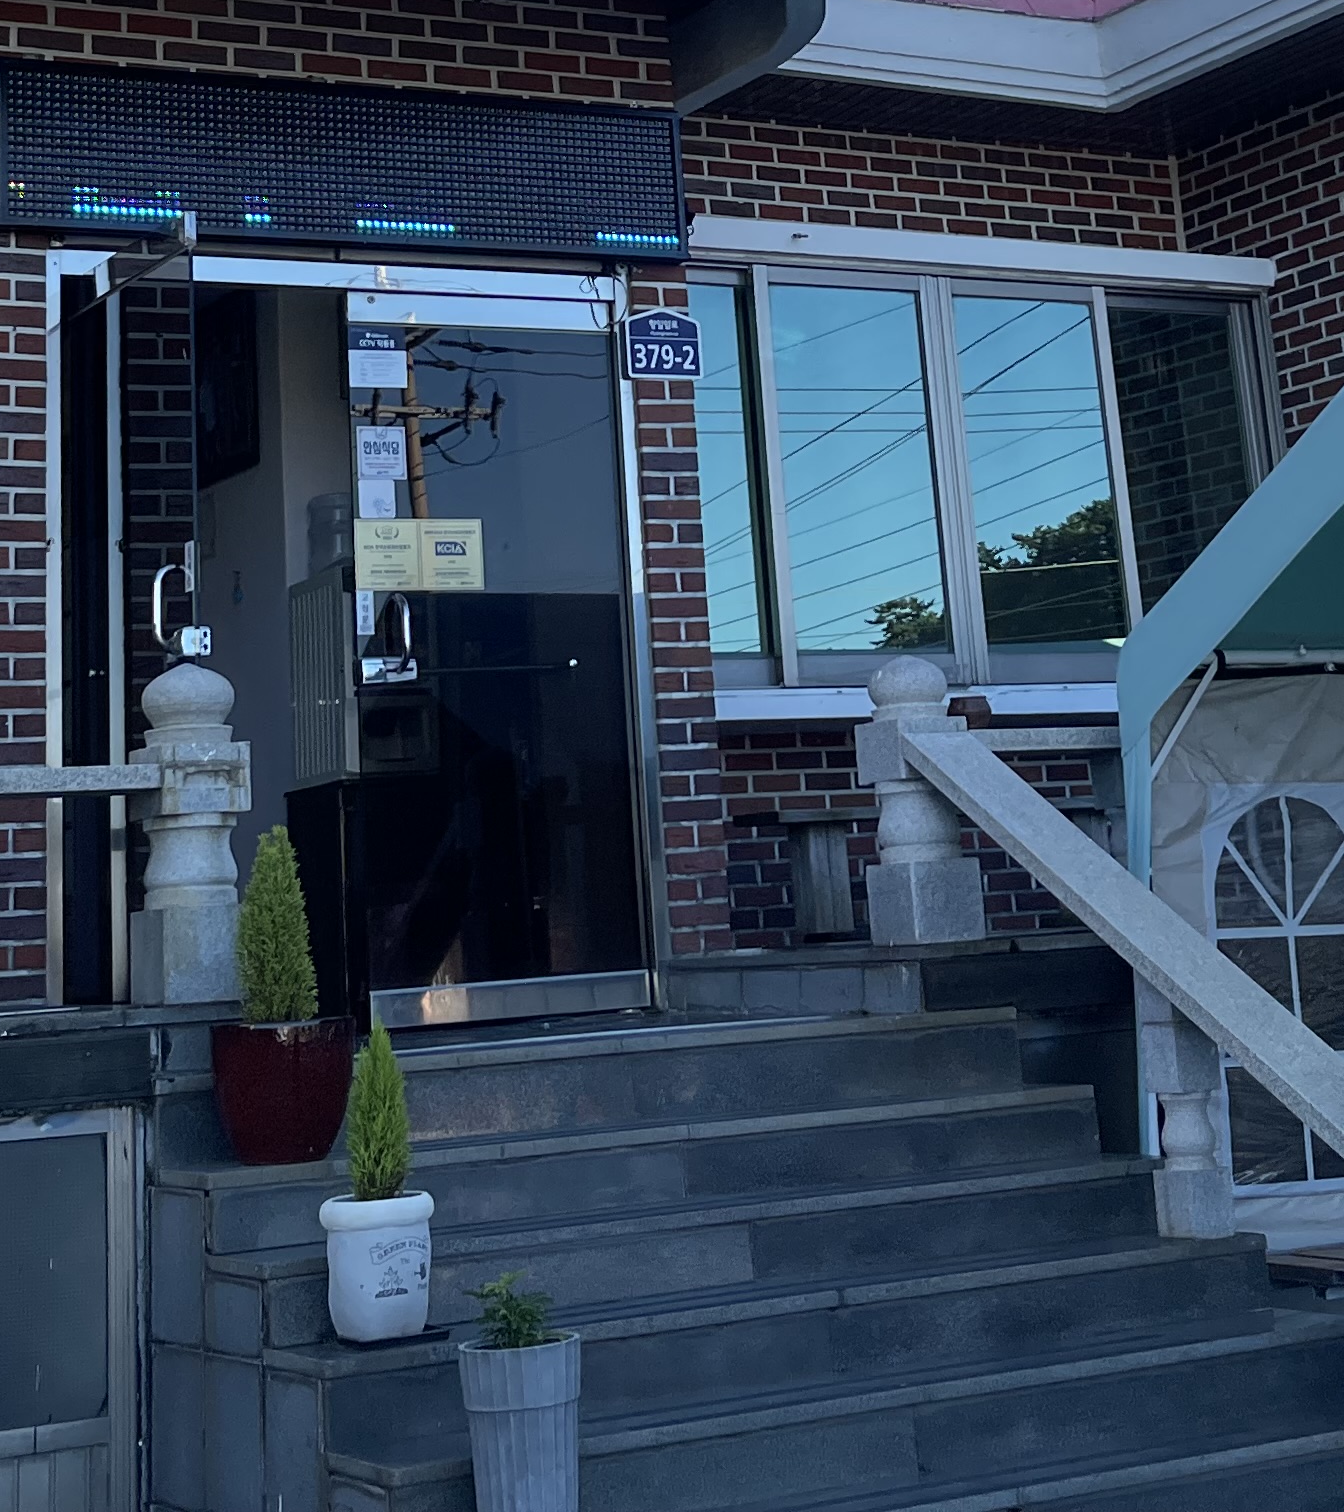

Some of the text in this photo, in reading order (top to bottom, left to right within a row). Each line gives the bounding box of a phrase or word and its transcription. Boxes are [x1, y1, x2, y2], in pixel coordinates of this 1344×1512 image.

[634, 343, 696, 370] 379-2
[363, 440, 400, 455] 안심식당
[436, 543, 463, 554] KCIA
